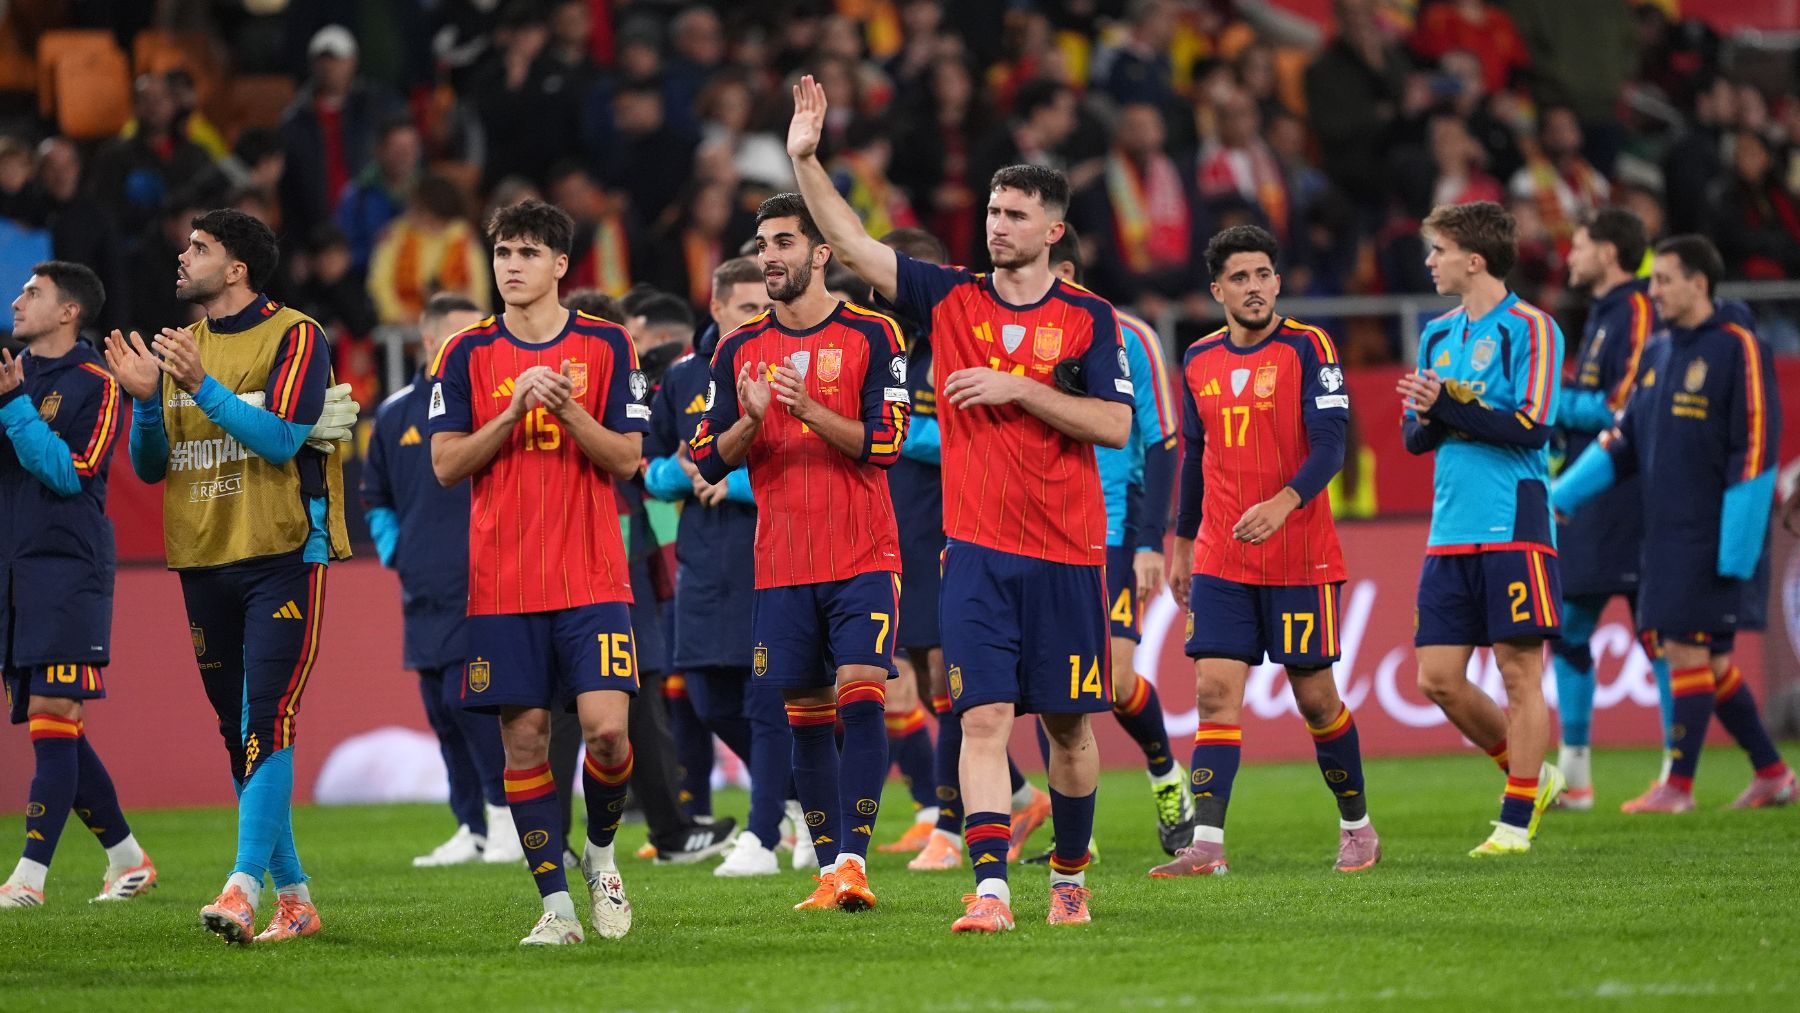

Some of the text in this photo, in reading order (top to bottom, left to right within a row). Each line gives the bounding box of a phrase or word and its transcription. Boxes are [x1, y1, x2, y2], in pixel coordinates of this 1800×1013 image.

[525, 407, 561, 452] 15
[1221, 406, 1250, 448] 17
[201, 478, 242, 498] REPECT
[1508, 581, 1530, 622] 2
[870, 612, 890, 654] 7
[1282, 613, 1314, 654] 17
[598, 633, 632, 677] 15
[1069, 655, 1102, 699] 14
